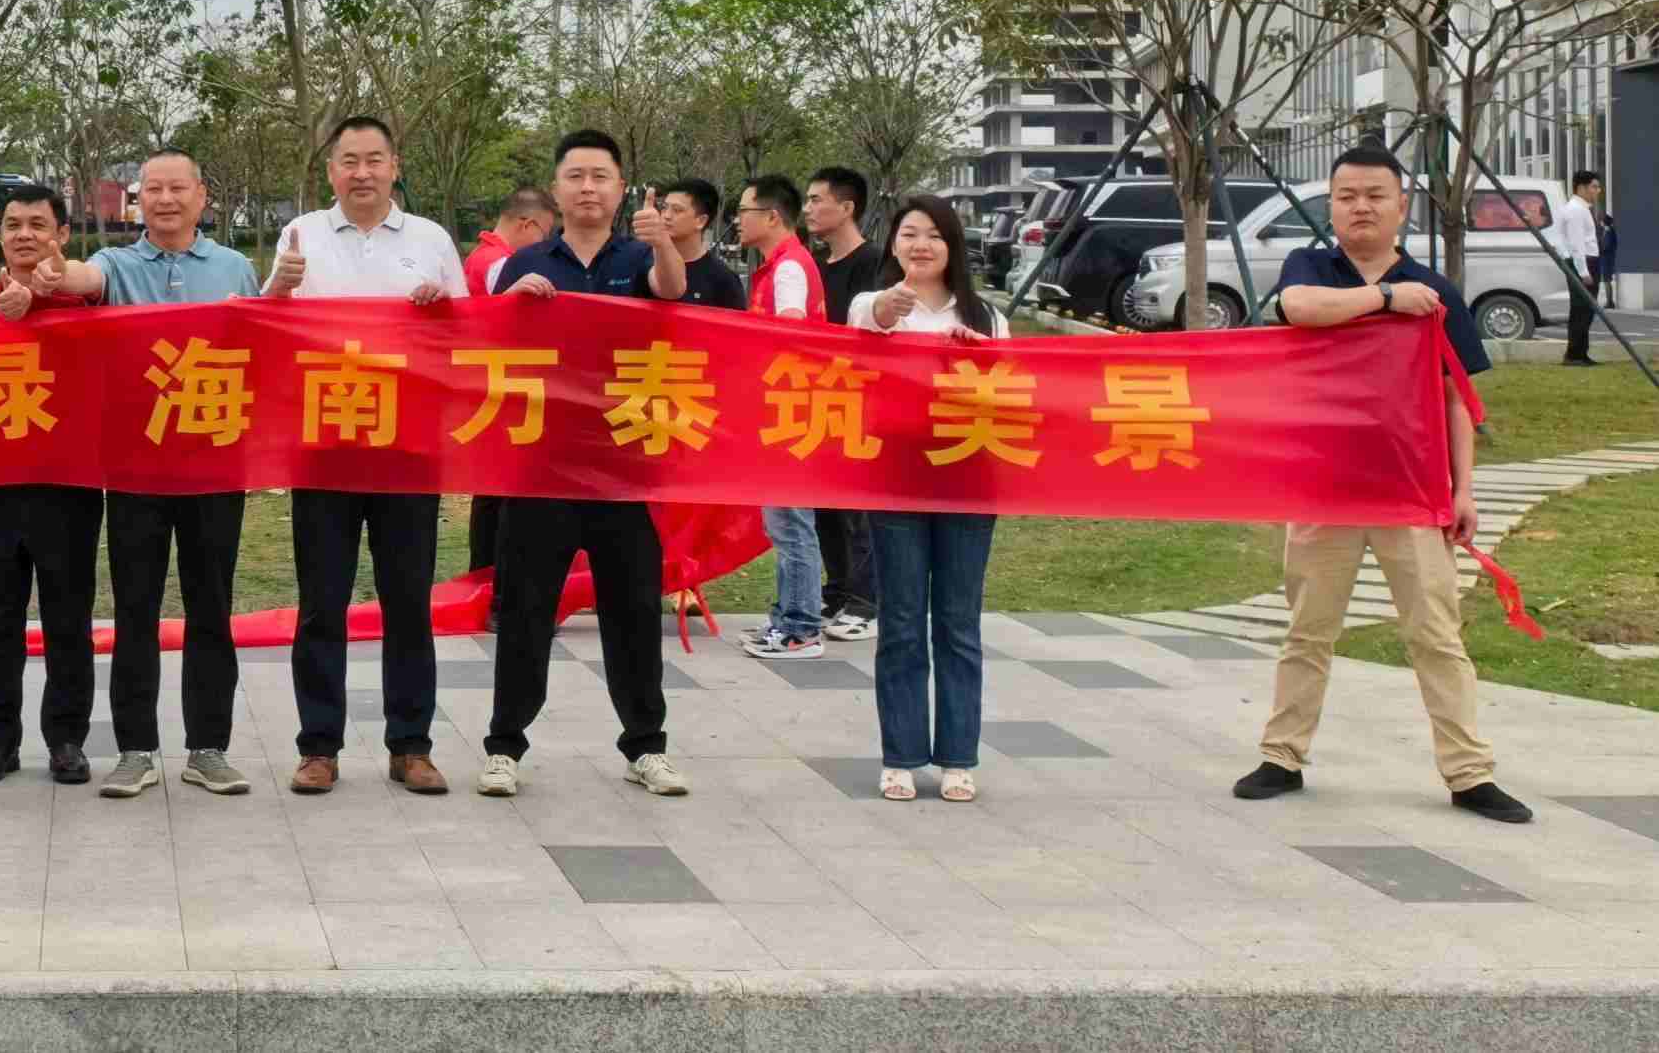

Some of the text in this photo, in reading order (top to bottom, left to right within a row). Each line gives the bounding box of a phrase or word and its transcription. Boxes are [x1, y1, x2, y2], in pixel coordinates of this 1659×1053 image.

[144, 337, 1211, 470] 海南万泰筑美景
